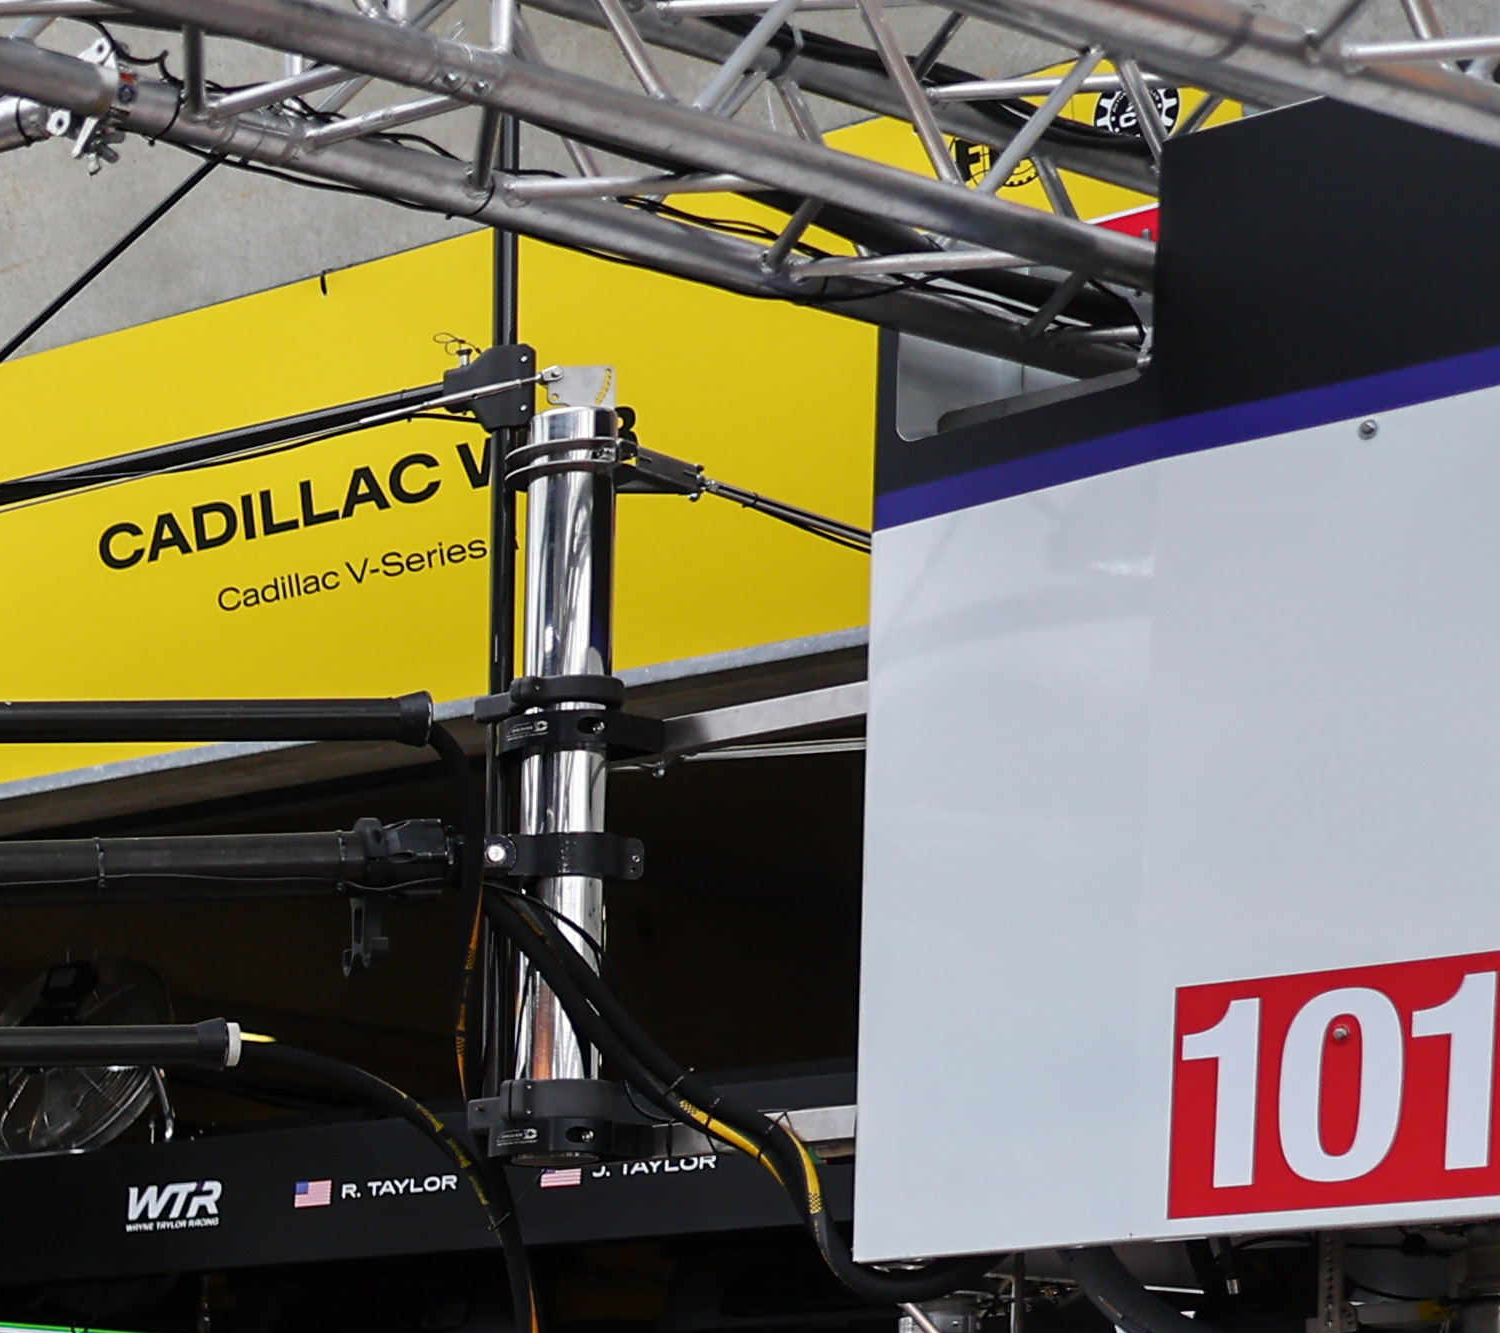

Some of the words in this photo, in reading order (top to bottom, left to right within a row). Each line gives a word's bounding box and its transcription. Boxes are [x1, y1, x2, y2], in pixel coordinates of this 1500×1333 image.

[99, 453, 441, 570] CADILLAC
[217, 569, 341, 612] Cadillac
[1182, 971, 1500, 1188] 101
[127, 1180, 222, 1221] WTR
[341, 1183, 361, 1199] R.
[368, 1174, 458, 1197] TAYLOR
